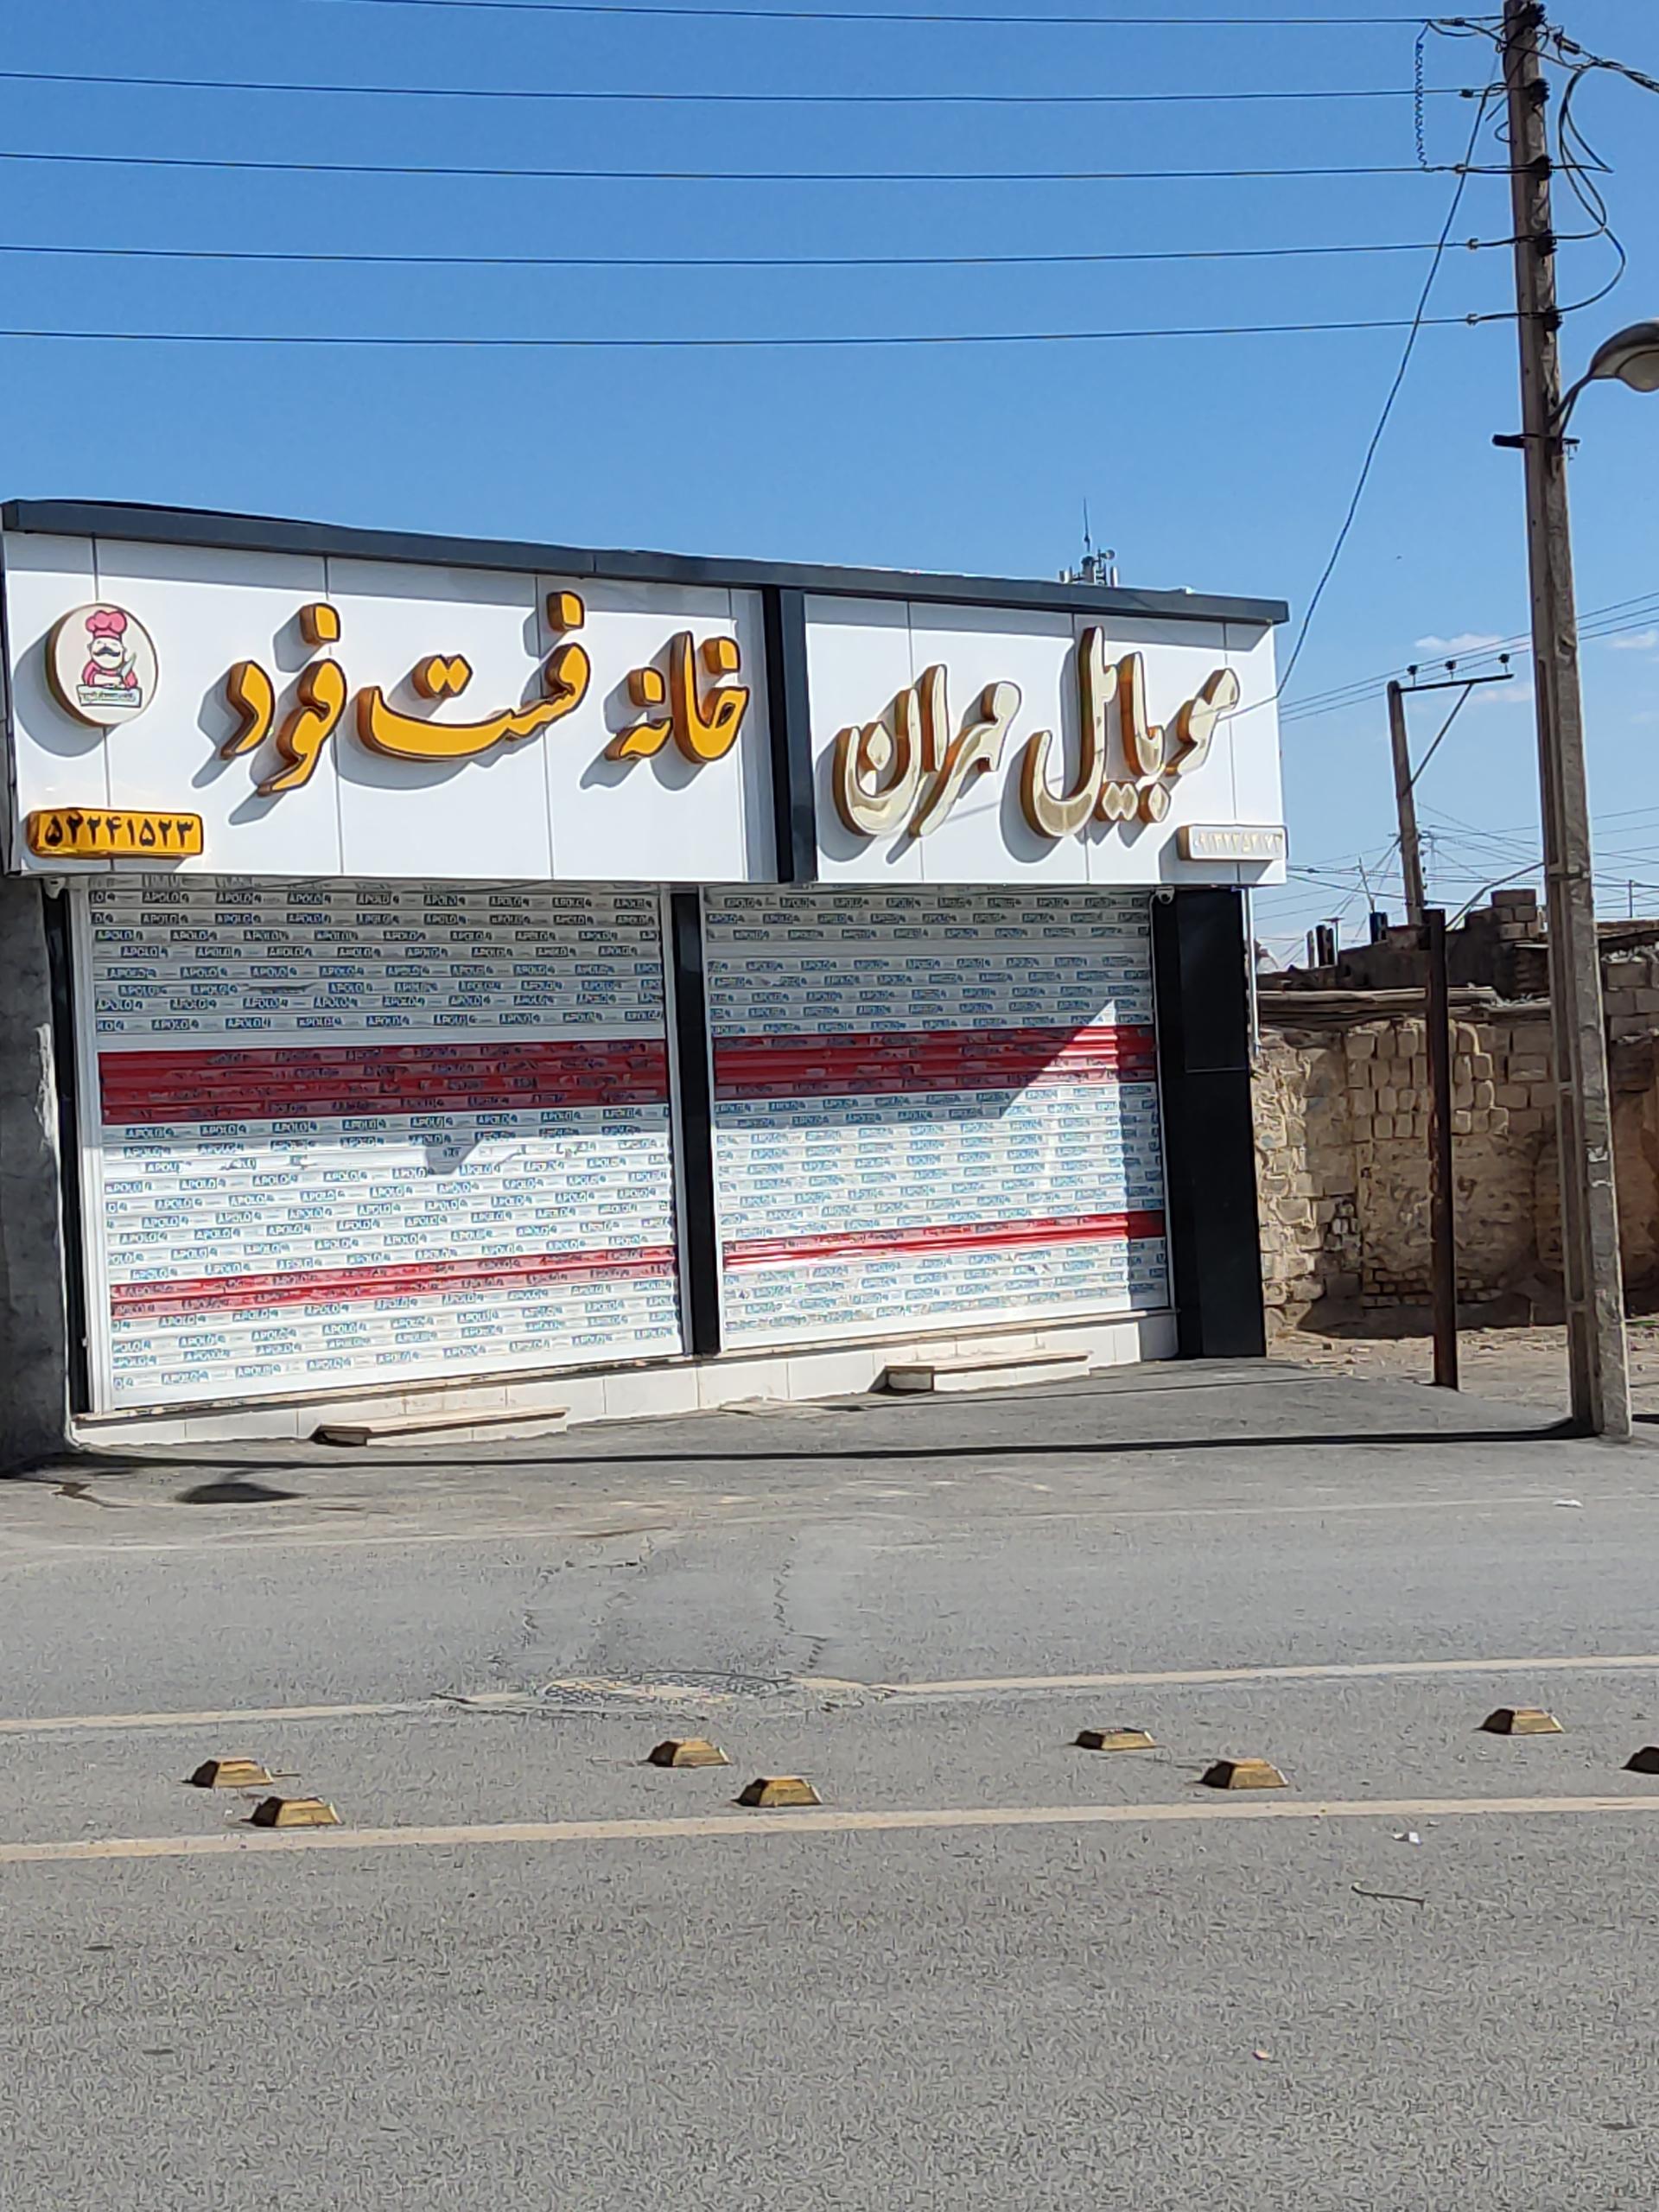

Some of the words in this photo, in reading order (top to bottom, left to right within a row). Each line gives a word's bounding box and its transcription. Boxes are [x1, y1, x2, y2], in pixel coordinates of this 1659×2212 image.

[220, 603, 346, 795] فود
[357, 591, 590, 761] فست
[607, 632, 749, 762] خانه
[832, 664, 1022, 838] مهران
[1020, 626, 1241, 839] موبایل
